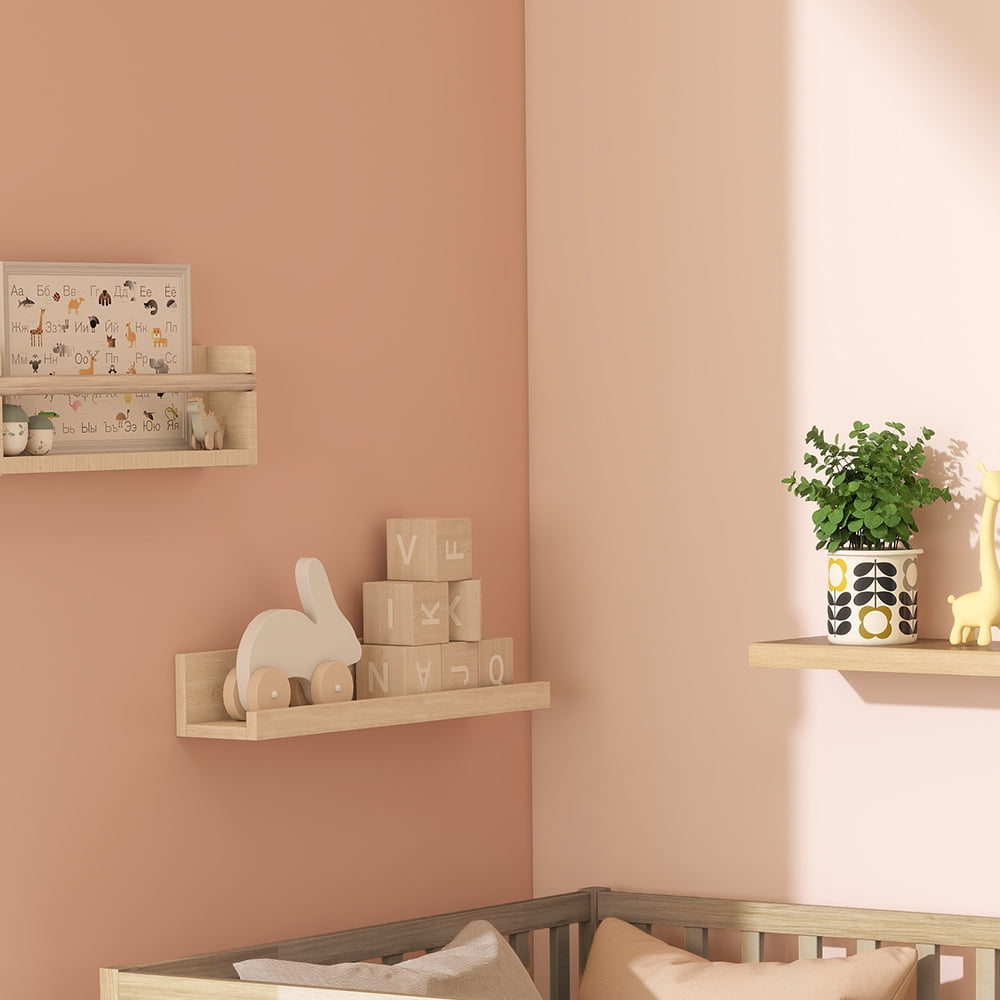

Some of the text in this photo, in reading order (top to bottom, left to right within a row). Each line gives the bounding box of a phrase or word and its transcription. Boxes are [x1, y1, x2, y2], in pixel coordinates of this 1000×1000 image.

[11, 284, 24, 297] Аа
[36, 284, 50, 297] Бб
[63, 284, 77, 297] Вв
[113, 285, 129, 298] Дд
[140, 286, 153, 298] Ее
[164, 283, 177, 298] Ёё
[11, 321, 29, 333] Жж
[45, 321, 58, 333] Зз
[74, 321, 89, 333] Ии
[11, 353, 28, 365] Мм
[74, 352, 89, 365] Оо
[105, 352, 119, 364] Пп
[135, 352, 148, 367] Рр
[396, 534, 417, 566] V
[445, 539, 465, 561] F
[420, 600, 441, 626] K
[368, 661, 389, 693] N
[416, 660, 432, 691] A
